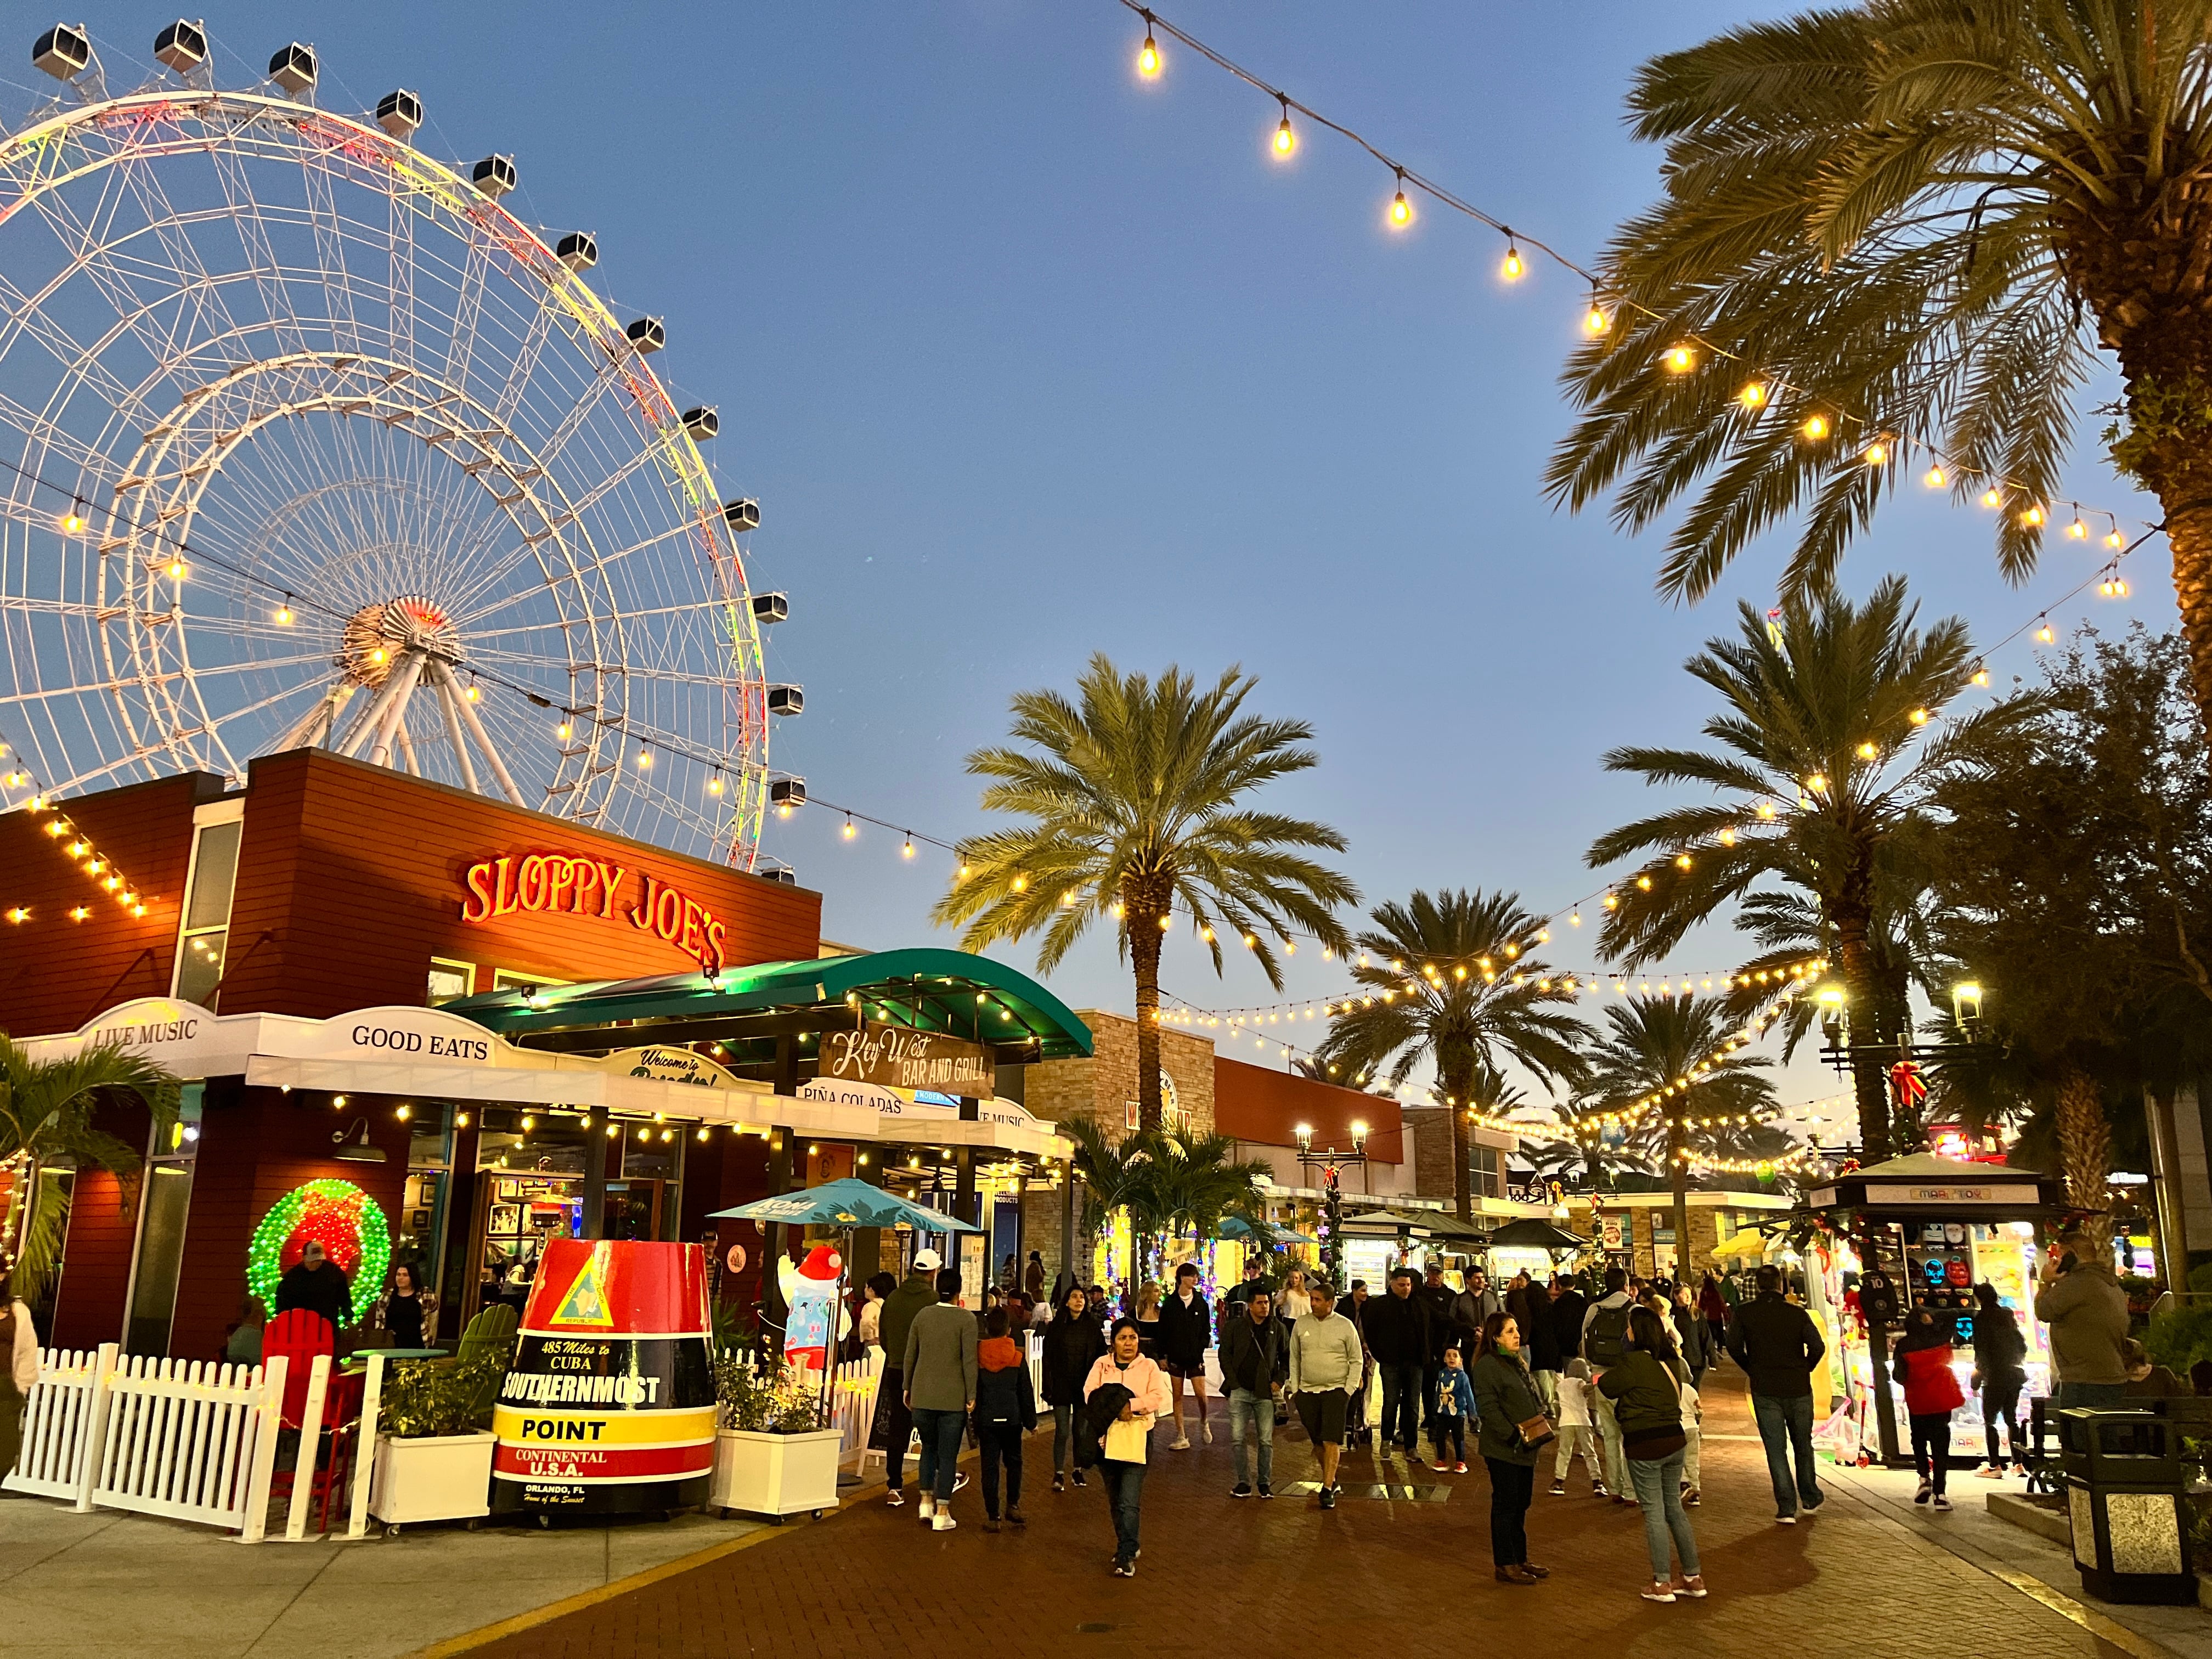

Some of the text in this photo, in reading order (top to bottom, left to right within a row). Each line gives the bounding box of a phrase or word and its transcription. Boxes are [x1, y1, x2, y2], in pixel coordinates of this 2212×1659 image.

[462, 854, 727, 970] SLOPPY JOE'S
[94, 1019, 198, 1048] LIVE MUSIC
[352, 1025, 487, 1060] GOOD EATS
[640, 1049, 688, 1070] Welcome
[832, 1028, 932, 1080] Key West
[901, 1057, 986, 1086] BAR AND GRILL
[919, 1092, 944, 1101] MODERN
[567, 1286, 575, 1296] THE
[1871, 1279, 1883, 1289] 10
[541, 1341, 610, 1356] 485 Miles to
[550, 1356, 591, 1370] CUBA
[501, 1372, 661, 1404] SOUTHERNMOST
[522, 1419, 607, 1440] POINT
[516, 1449, 607, 1463] CONTINENTAL
[530, 1462, 584, 1477] U.S.A.
[526, 1485, 571, 1494] ORLANDO,
[541, 1495, 549, 1505] of
[550, 1494, 560, 1503] the
